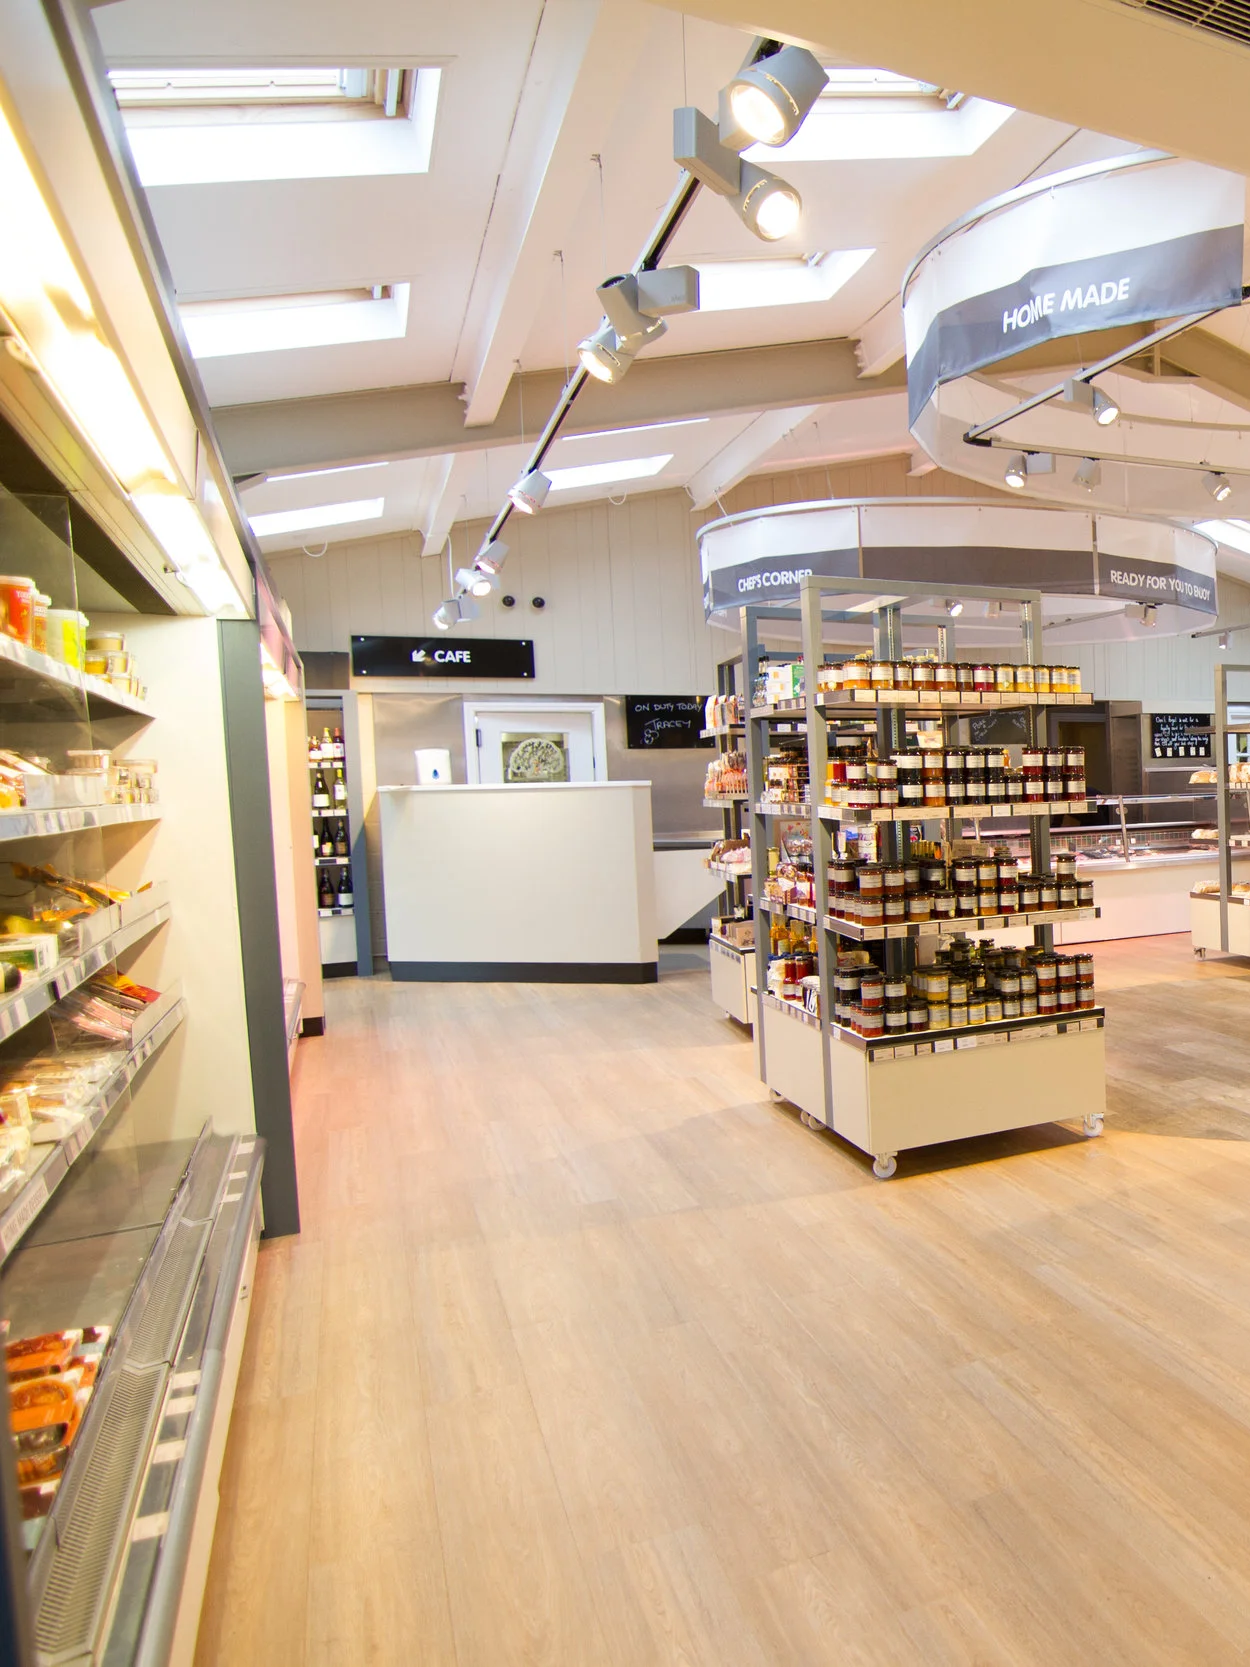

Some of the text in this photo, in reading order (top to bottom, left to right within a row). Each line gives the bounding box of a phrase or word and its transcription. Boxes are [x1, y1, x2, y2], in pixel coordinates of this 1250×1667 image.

[1002, 277, 1131, 334] HOME MADE
[738, 571, 763, 593] CHEF'S
[1110, 570, 1145, 587] READY
[1146, 575, 1166, 591] FOR
[1168, 578, 1184, 592] YOU
[1184, 582, 1193, 596] TO
[434, 650, 472, 663] CAFE
[634, 702, 703, 712] ON DUTY TODAY
[644, 718, 691, 730] TRACEY
